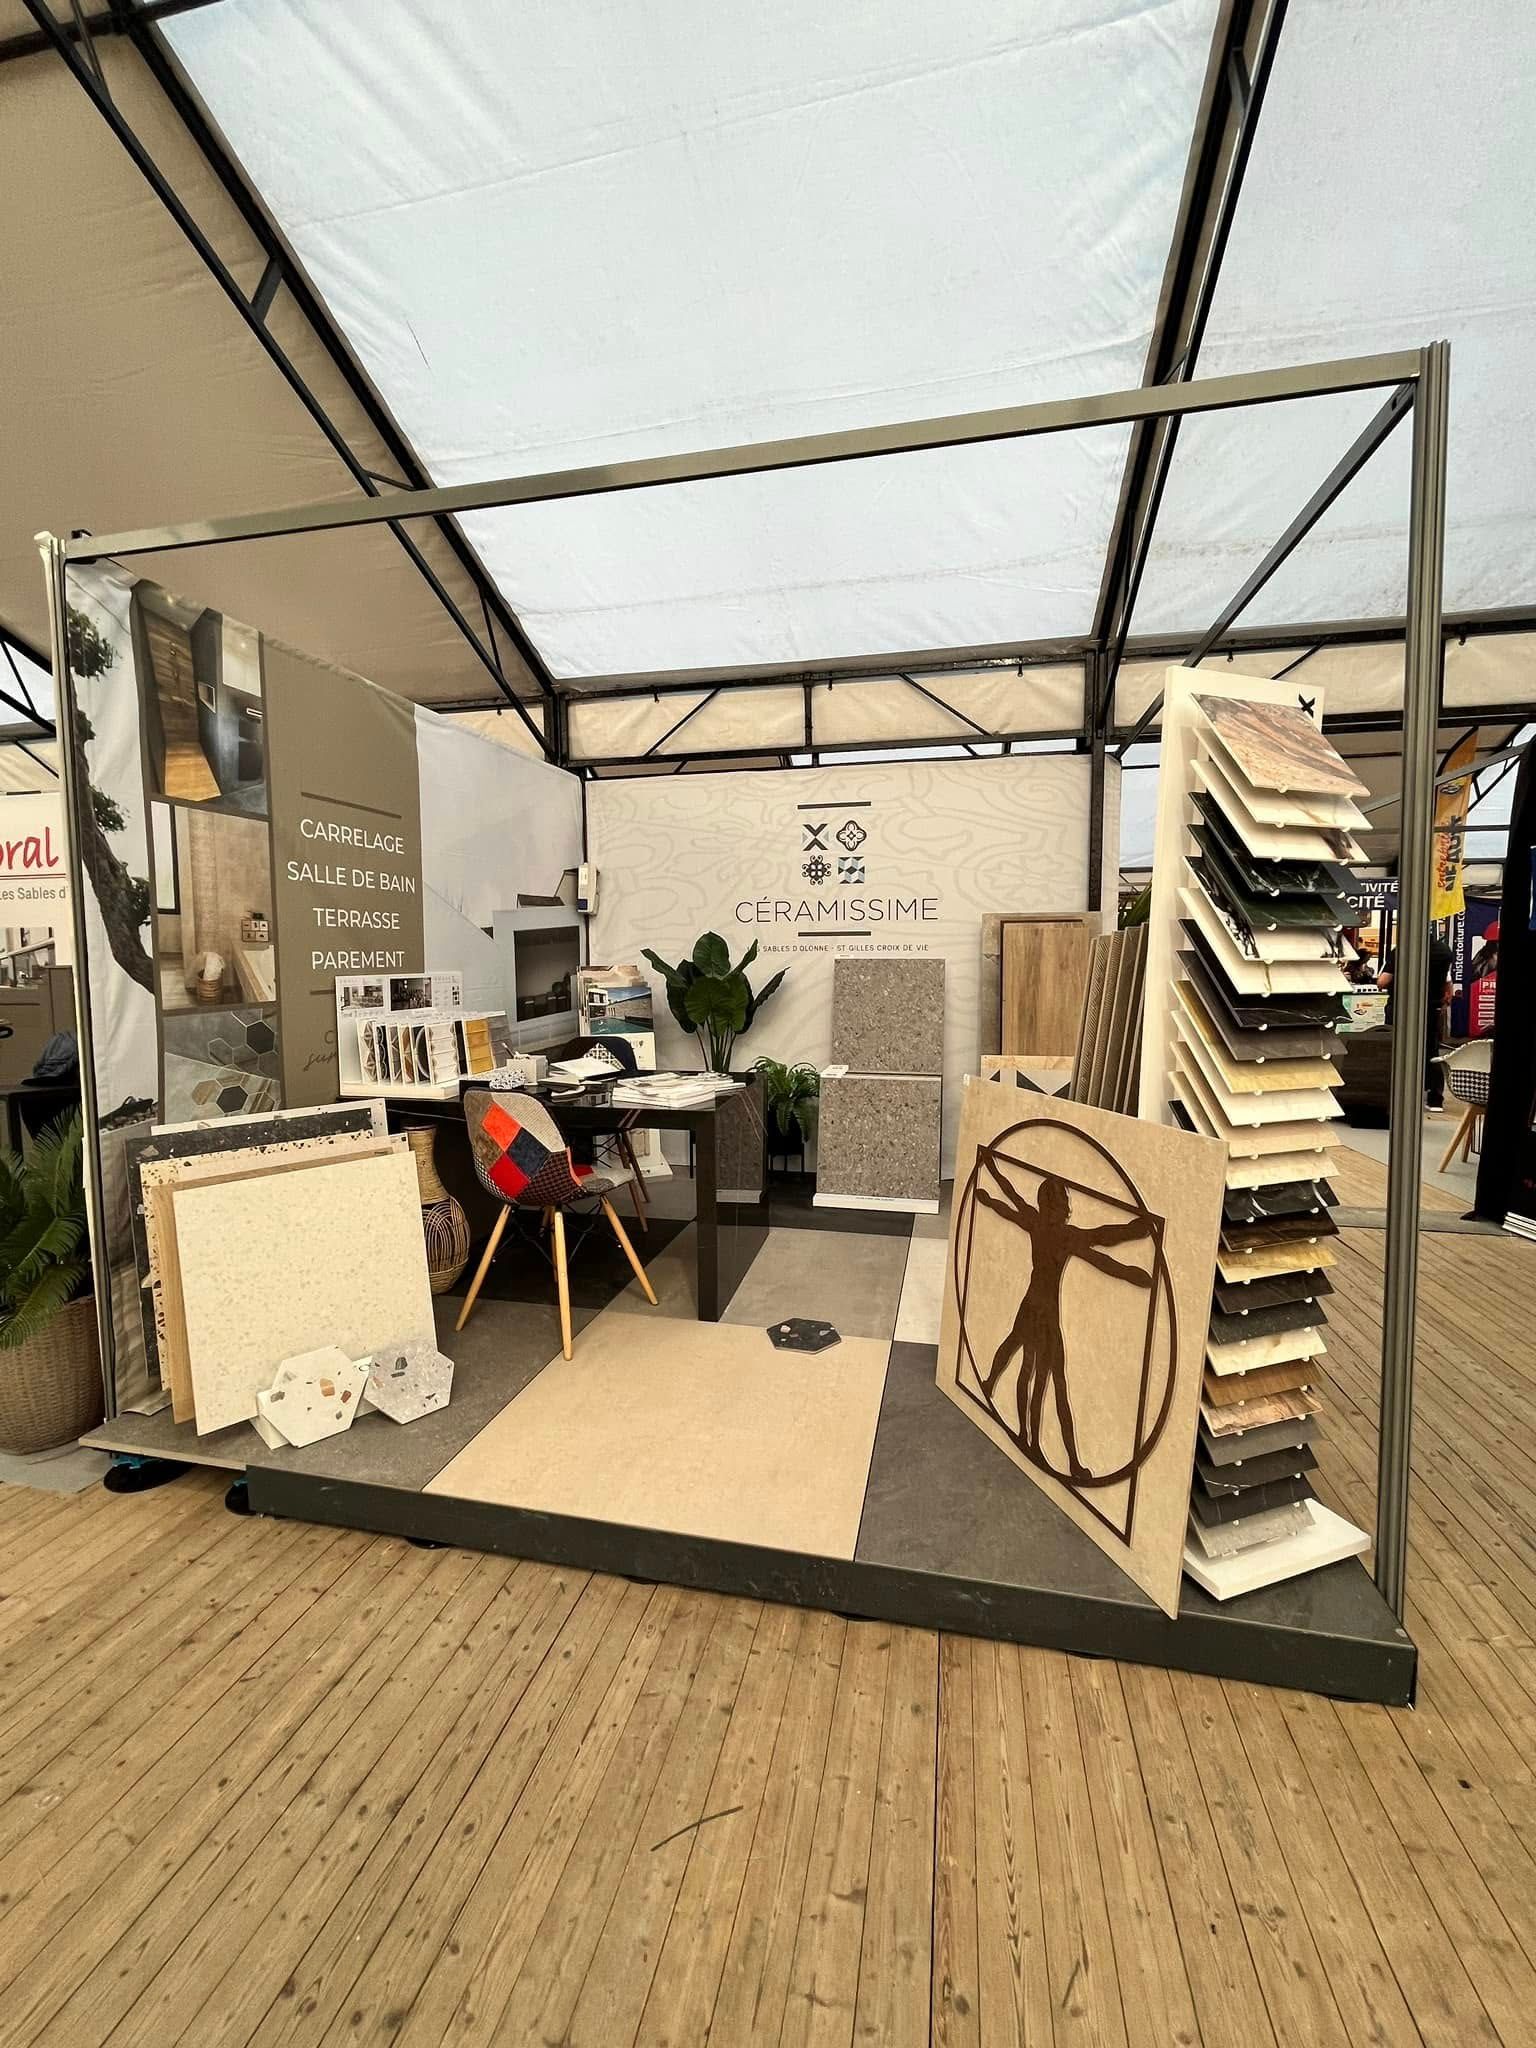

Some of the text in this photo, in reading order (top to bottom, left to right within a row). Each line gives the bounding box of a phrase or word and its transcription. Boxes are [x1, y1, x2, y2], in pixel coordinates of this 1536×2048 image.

[300, 818, 405, 855] CARRELAGE
[287, 861, 416, 894] SALLE DE BAIN
[17, 887, 56, 900] Sables
[312, 907, 401, 930] TERRASSE
[736, 896, 939, 923] CÉRAMISSIME
[848, 944, 874, 952] GILLES
[876, 944, 900, 952] CROIX
[903, 944, 913, 952] DE
[916, 944, 929, 952] VIE
[311, 951, 405, 969] PAREMENT
